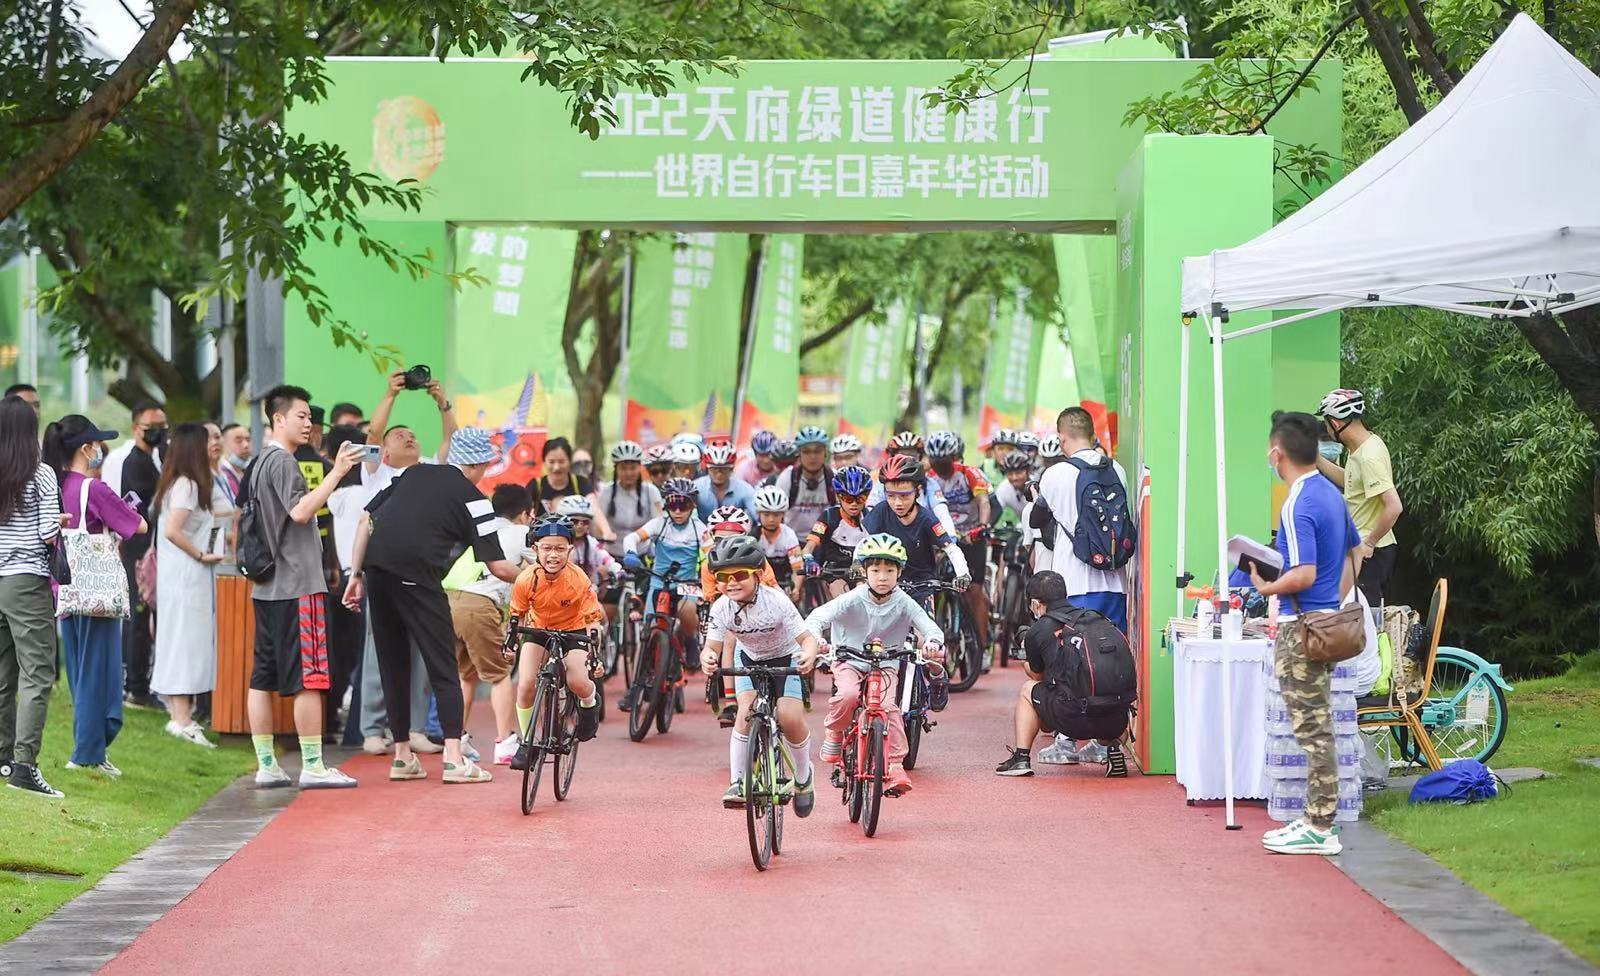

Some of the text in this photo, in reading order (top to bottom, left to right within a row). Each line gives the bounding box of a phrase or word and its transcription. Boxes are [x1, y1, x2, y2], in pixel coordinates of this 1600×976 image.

[581, 153, 1049, 198] ——世界自行车日嘉年华活动
